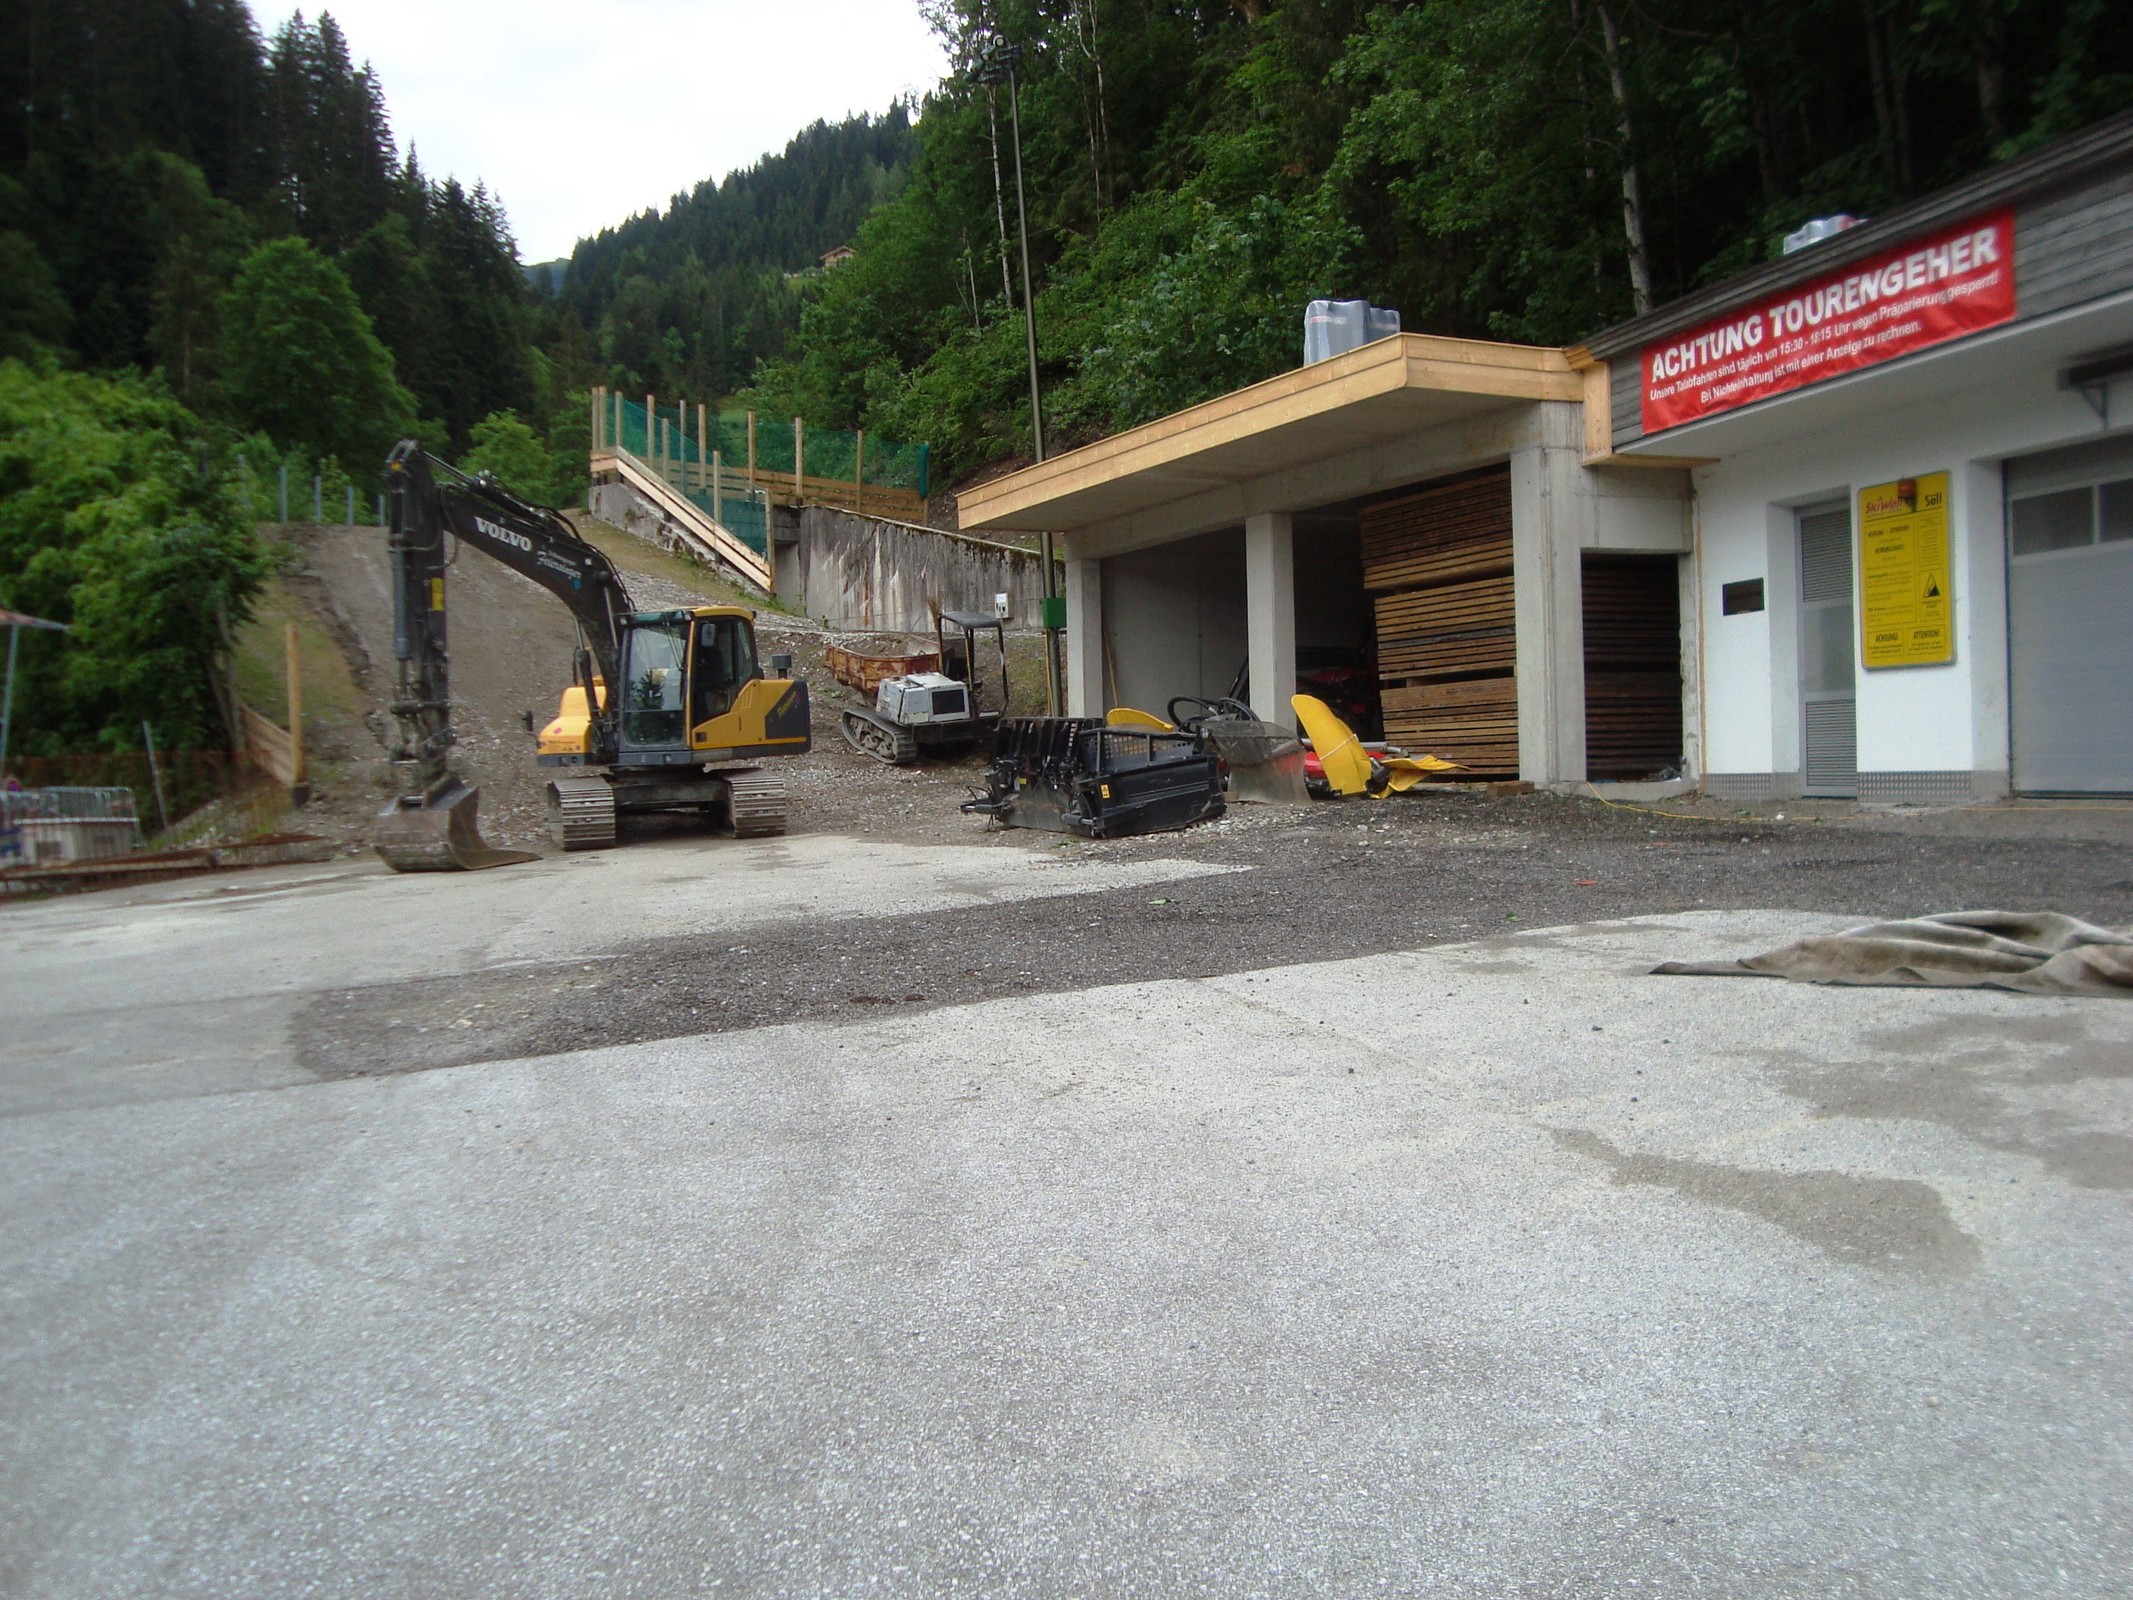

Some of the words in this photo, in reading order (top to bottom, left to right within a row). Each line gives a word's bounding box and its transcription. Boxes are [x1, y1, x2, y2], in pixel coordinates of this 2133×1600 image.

[1650, 385, 1676, 400] Unsere
[1676, 370, 1718, 391] Talabfahrten
[1718, 361, 1736, 378] sind
[1737, 351, 1763, 371] täglich
[1765, 347, 1778, 361] von
[1779, 336, 1804, 356] 15:30
[1834, 321, 1851, 336] Uhr
[1852, 311, 1878, 331] wegen
[1880, 290, 1949, 319] Präparierung
[1651, 314, 1763, 383] ACHTUNG
[1769, 225, 1999, 338] TOURENGEHER
[1701, 388, 1712, 403] Bei
[1712, 368, 1774, 399] Nichteinhaltung
[1774, 362, 1786, 377] ist
[1786, 357, 1801, 373] mit
[1801, 351, 1825, 367] einer
[1826, 340, 1863, 360] Anzeige
[1862, 335, 1875, 347] zu
[1877, 321, 1922, 343] rechnen.
[474, 515, 532, 552] VOLVO
[1925, 490, 1943, 507] Söll
